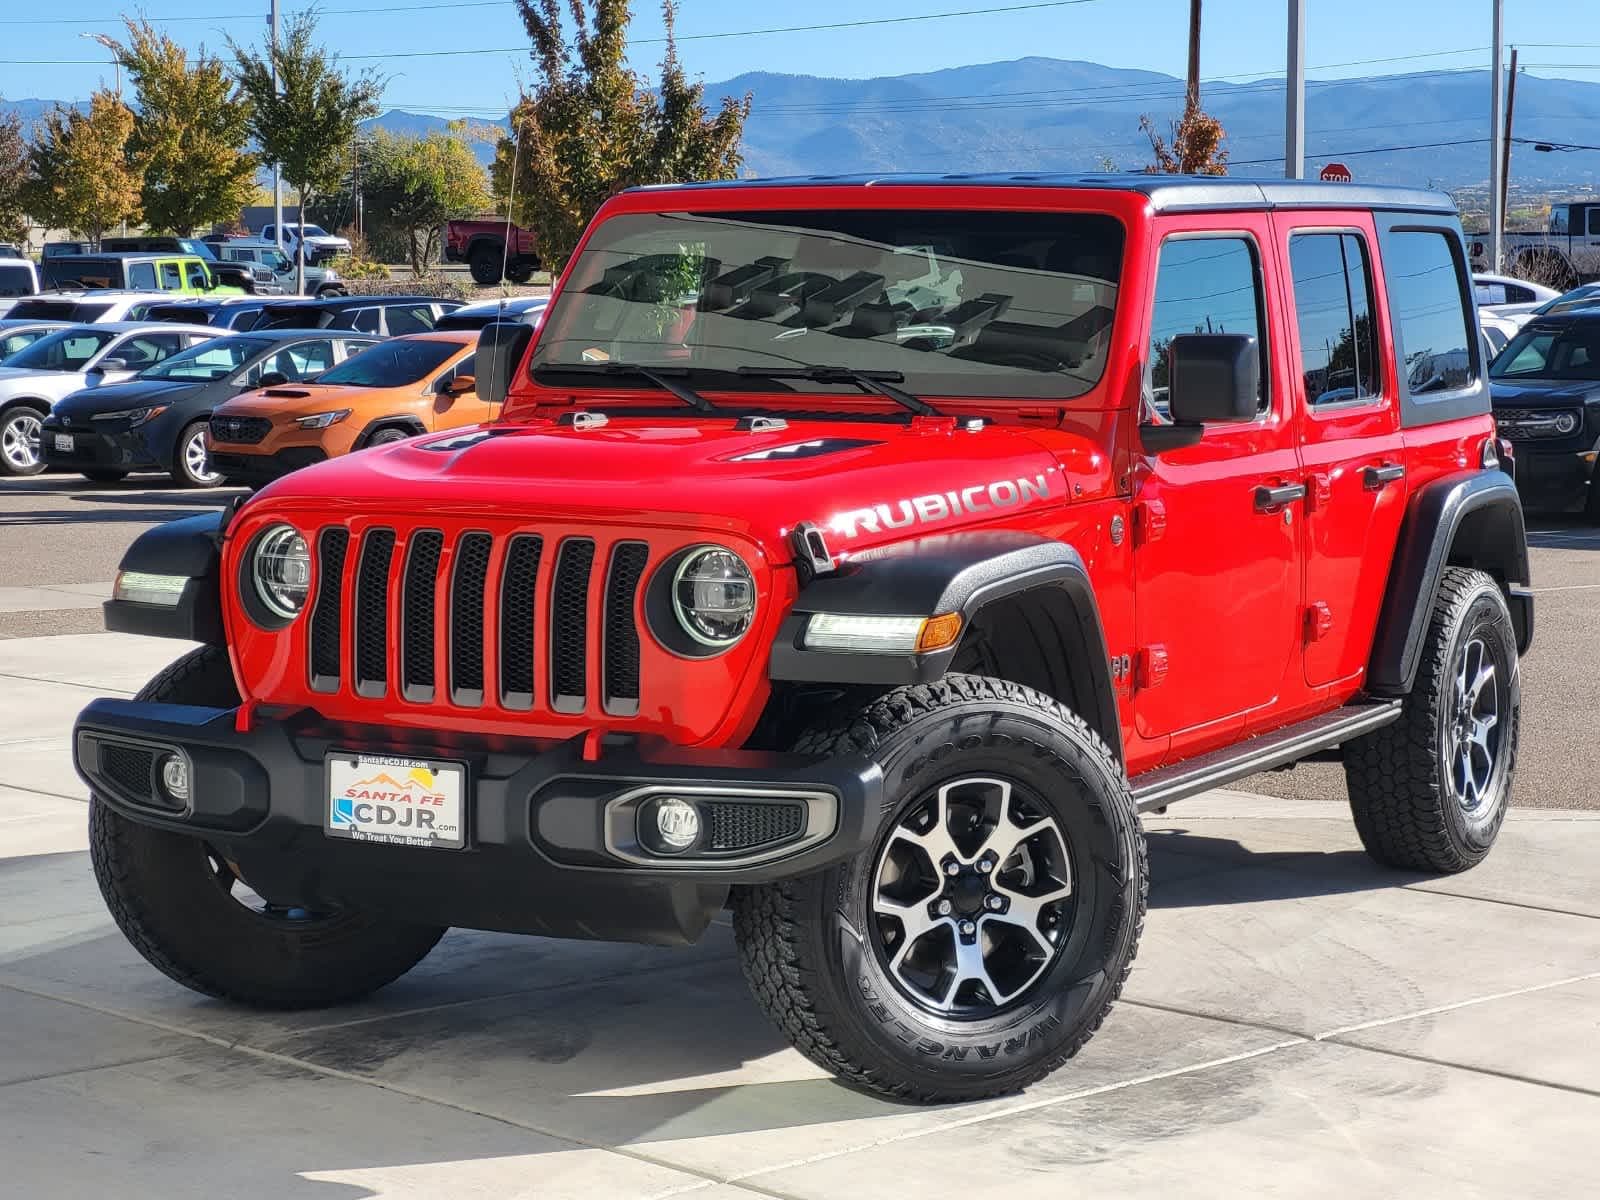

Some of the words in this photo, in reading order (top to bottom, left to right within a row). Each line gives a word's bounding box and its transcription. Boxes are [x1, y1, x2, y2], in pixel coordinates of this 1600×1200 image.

[1322, 173, 1350, 183] STOP
[828, 474, 1049, 537] RUBICON
[358, 755, 428, 768] SantaFeCDJR.com
[345, 789, 412, 803] SANTA
[420, 796, 446, 806] FE
[352, 831, 365, 841] We
[389, 834, 404, 845] You
[406, 837, 432, 847] Better
[857, 976, 1062, 1061] WRANGLER
